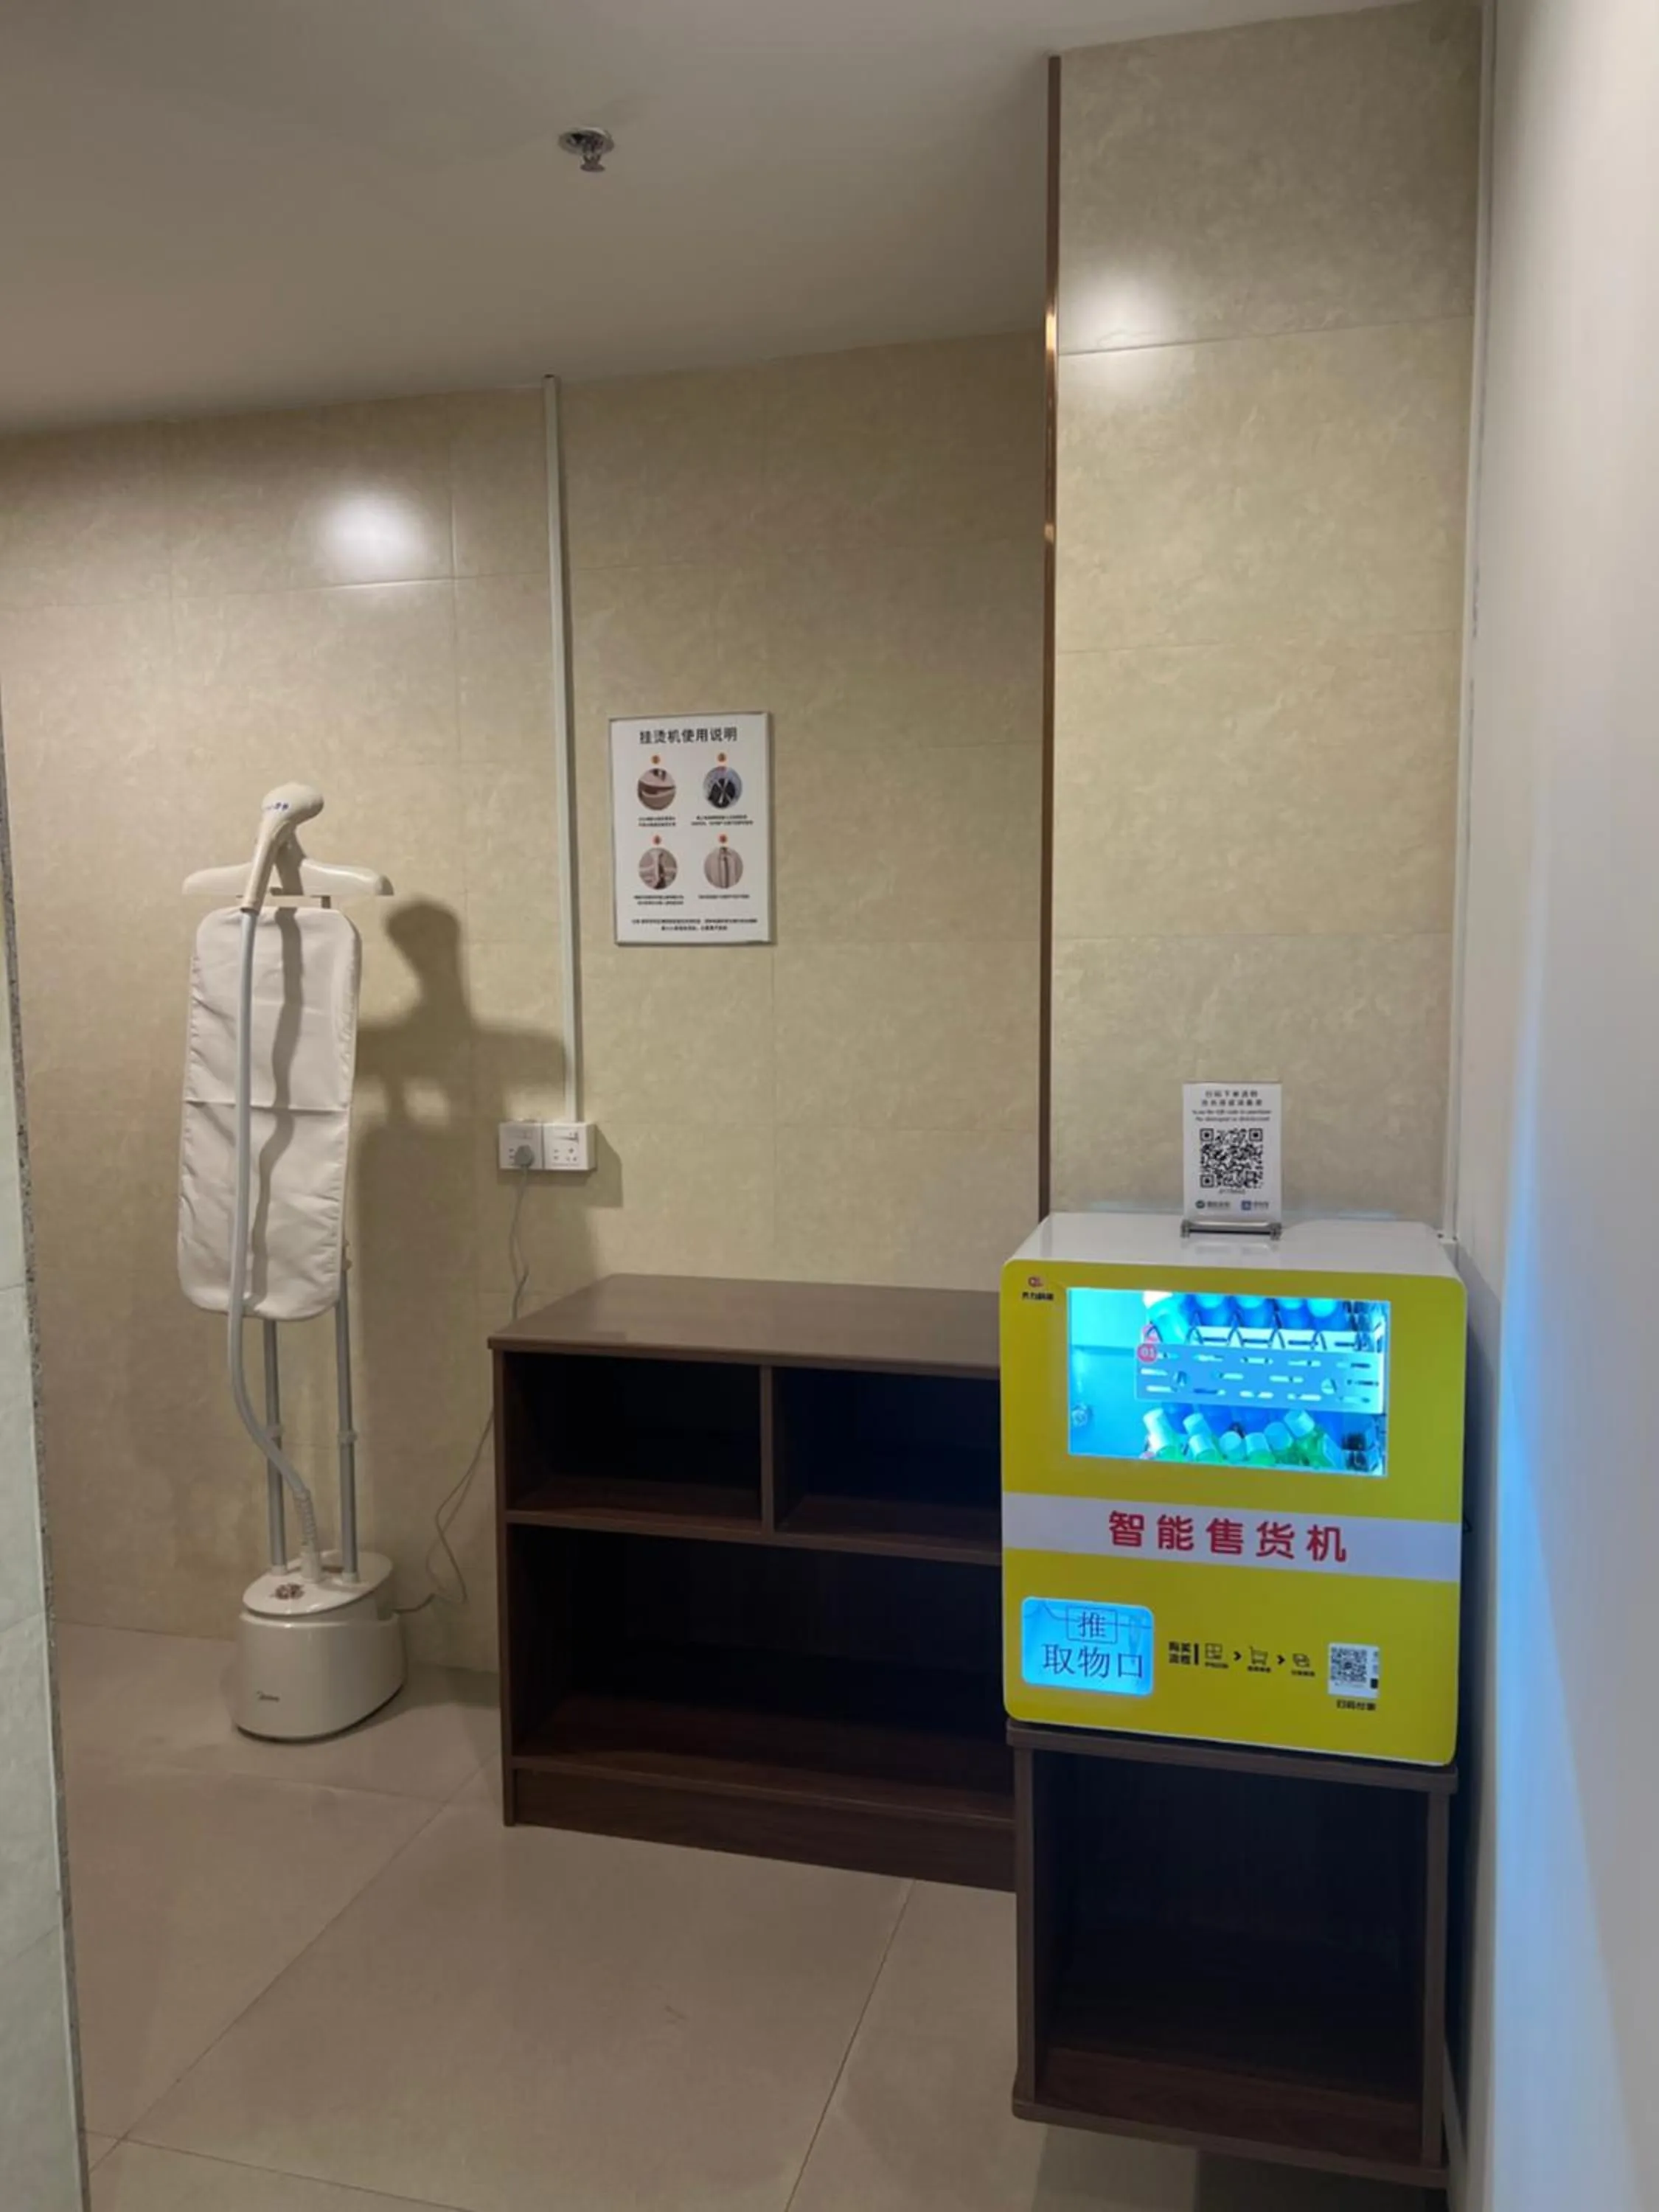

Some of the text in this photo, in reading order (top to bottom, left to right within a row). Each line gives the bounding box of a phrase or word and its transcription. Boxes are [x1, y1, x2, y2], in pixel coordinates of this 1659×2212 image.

[639, 726, 737, 744] 挂烫机使用说明
[1108, 1510, 1346, 1563] 智能售货机
[1077, 1610, 1106, 1638] 推
[1042, 1643, 1143, 1679] 取物口
